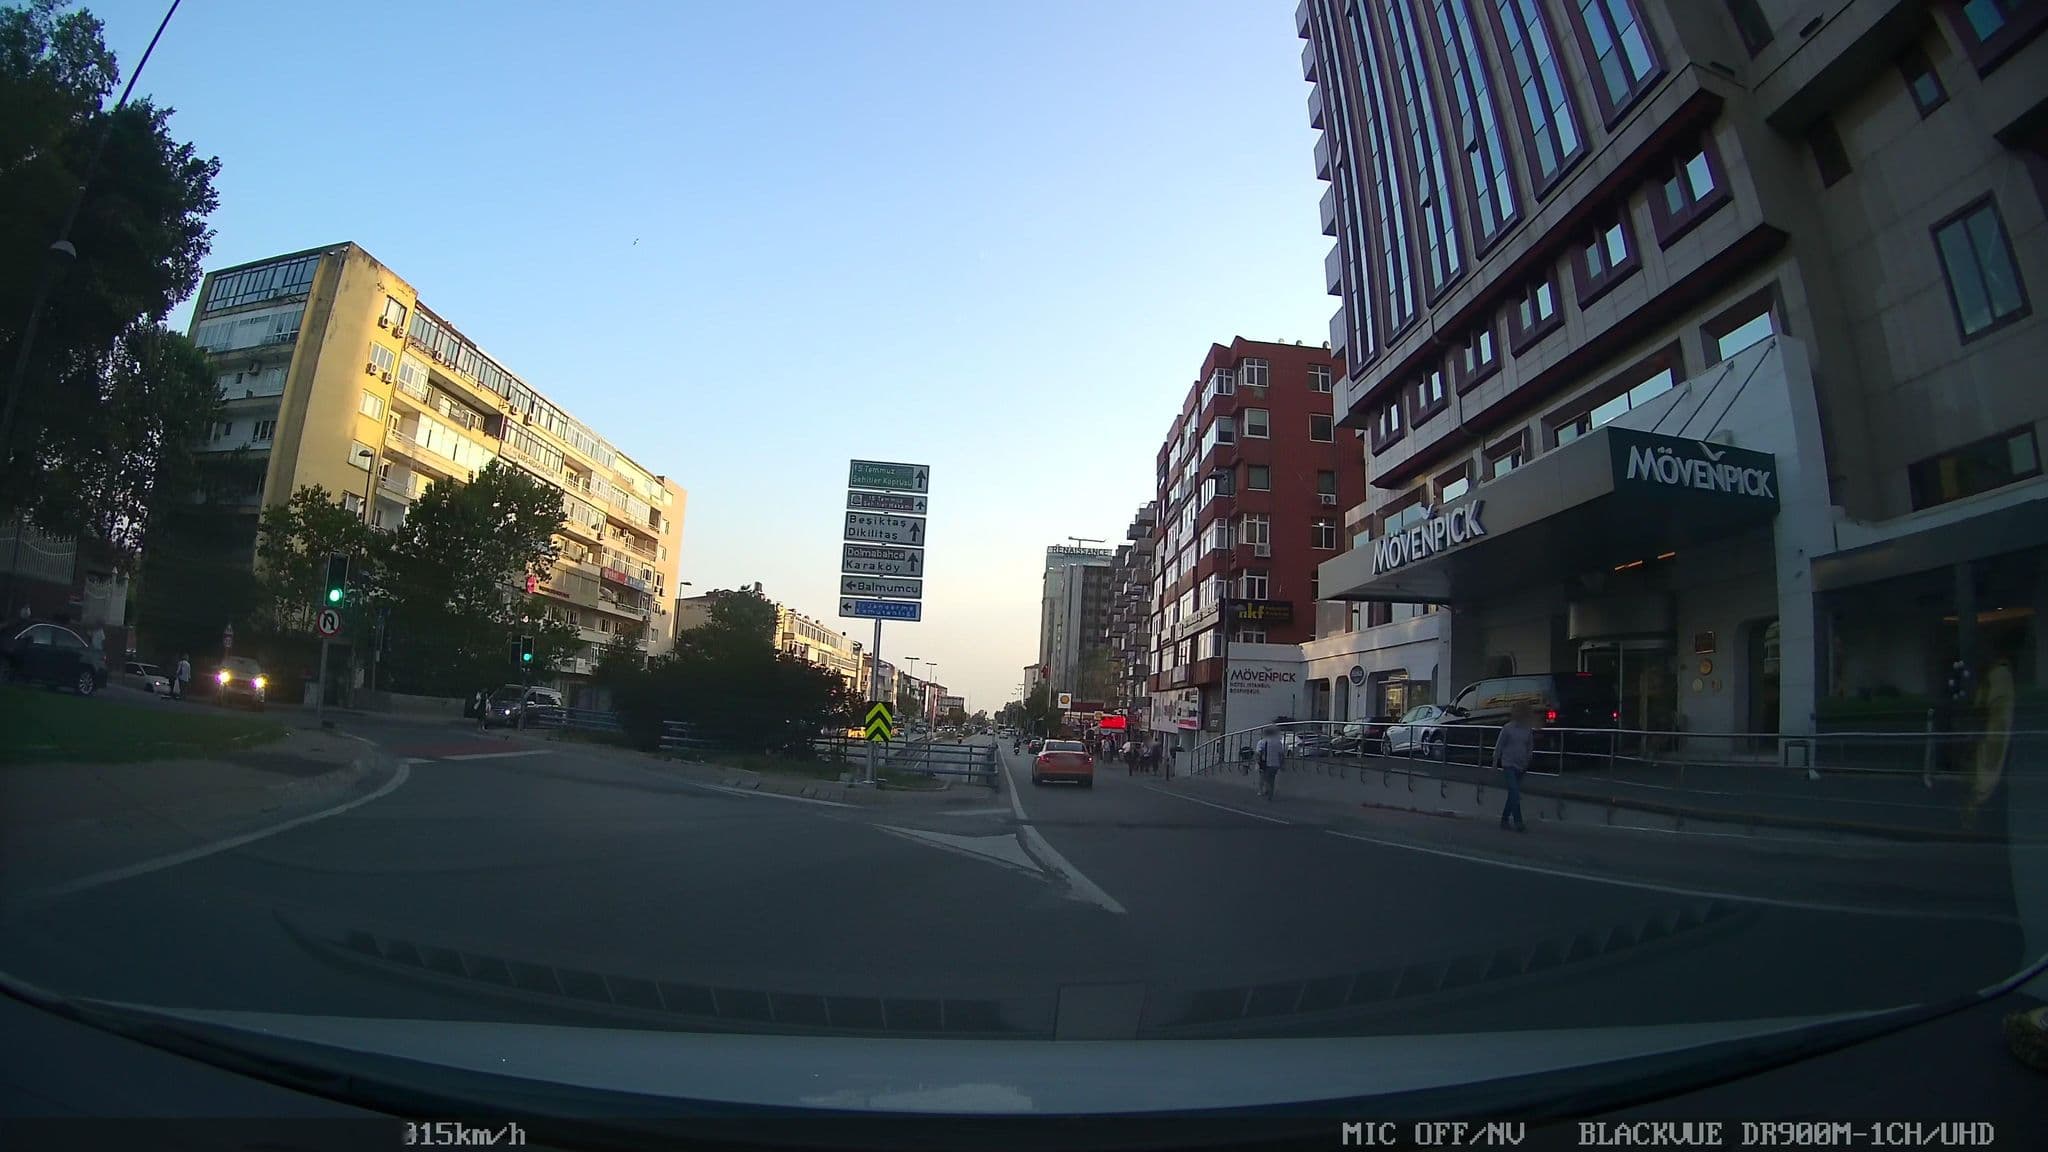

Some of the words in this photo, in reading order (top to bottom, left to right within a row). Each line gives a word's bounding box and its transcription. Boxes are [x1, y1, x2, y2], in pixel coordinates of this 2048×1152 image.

[864, 464, 896, 475] Temmuz
[1626, 444, 1775, 499] MÖVENPICK
[1371, 499, 1485, 575] MÖVENPICK
[857, 581, 918, 593] Balmumcu
[1230, 667, 1297, 683] MÖVENPICK
